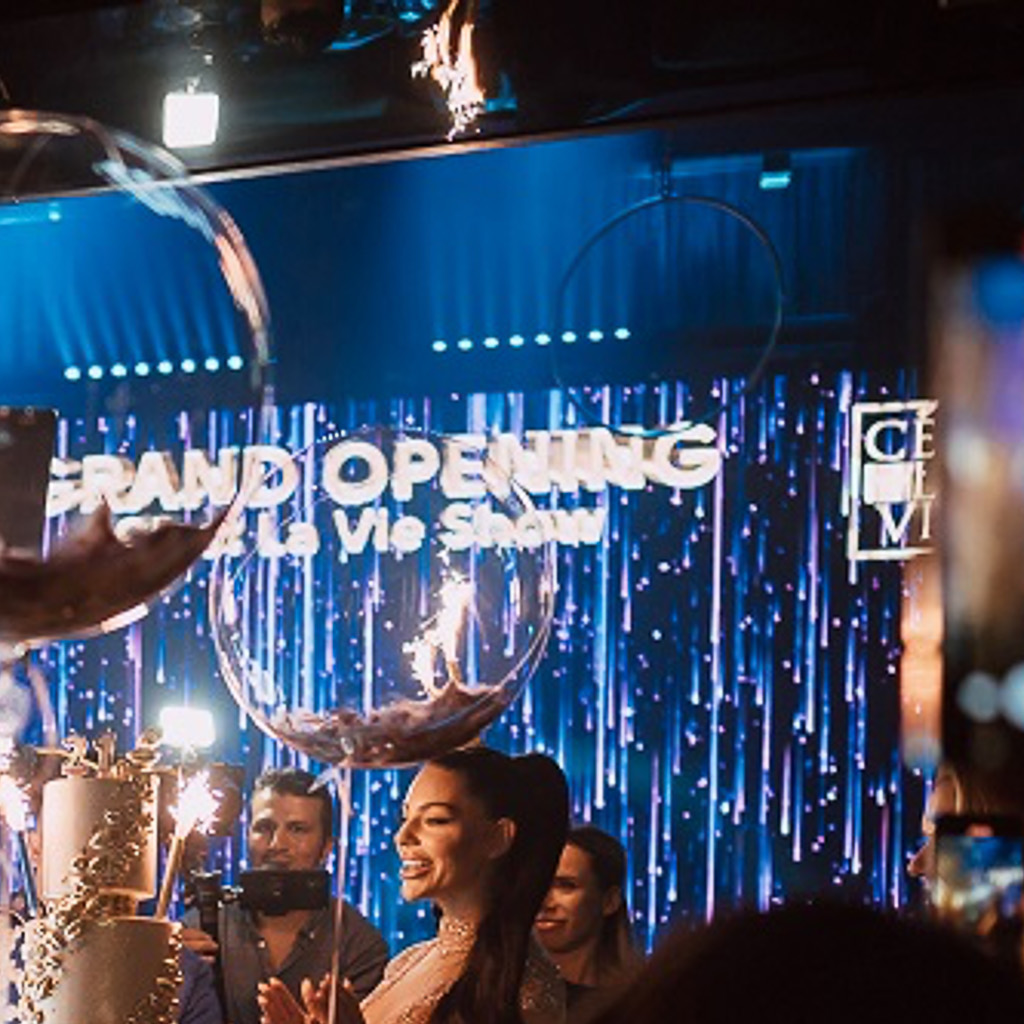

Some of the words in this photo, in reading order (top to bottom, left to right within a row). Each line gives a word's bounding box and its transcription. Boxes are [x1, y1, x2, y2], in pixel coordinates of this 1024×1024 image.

[322, 424, 722, 505] OPENING
[256, 511, 321, 558] La
[333, 506, 426, 554] Vie
[436, 501, 608, 551] Show
